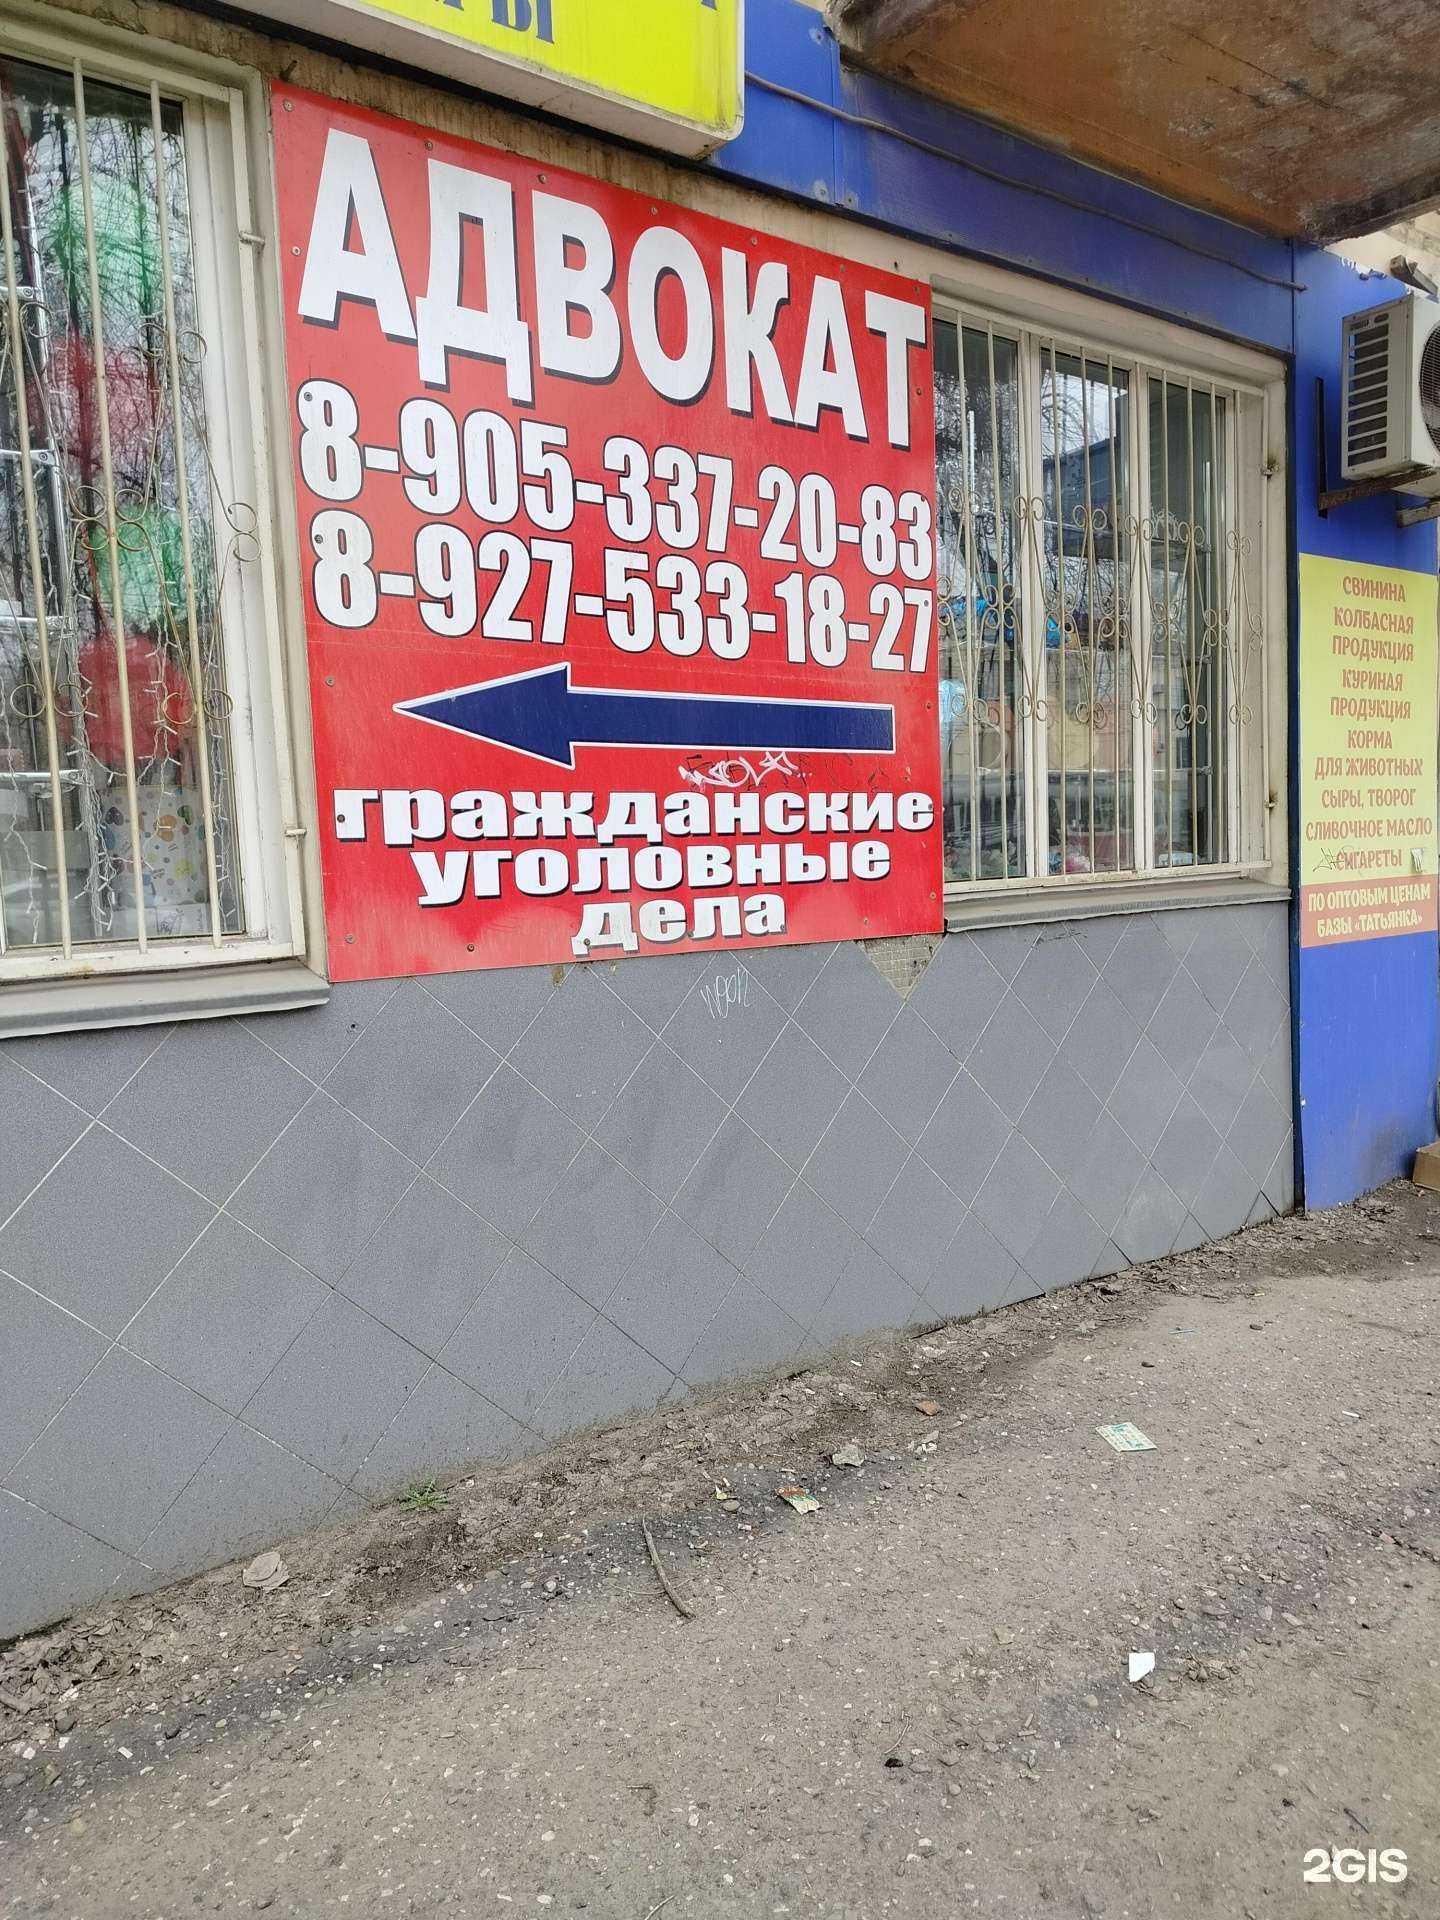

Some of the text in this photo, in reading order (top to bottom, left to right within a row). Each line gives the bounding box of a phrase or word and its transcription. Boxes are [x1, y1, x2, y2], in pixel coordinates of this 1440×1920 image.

[298, 128, 928, 451] АДВОКАТ
[298, 378, 933, 581] 8-905-337-20-83
[310, 509, 933, 673] 8-927-533-18-27
[1343, 576, 1406, 602] СВИНИНА
[1333, 606, 1414, 635] КОЛБАСНАЯ
[1332, 635, 1414, 664] ПРОДУКЦИЯ
[1342, 669, 1403, 691] КУРИНАЯ
[1330, 697, 1411, 722] ПРОДУКЦИЯ
[1347, 730, 1392, 749] КОРМА
[1315, 757, 1423, 780] ДЛЯ ЖИВОТНЫХ
[1321, 788, 1416, 810] СЫРЫ, ТВОРОГ
[332, 788, 935, 846] гражданские
[1306, 817, 1433, 841] СЛИВОЧНОЕ МАСЛО
[410, 838, 891, 907] уголовные
[1336, 848, 1403, 871] СИГАРЕТЫ
[1308, 883, 1431, 912] ПО ОПТОВЫМ ЦЕНАМ
[571, 893, 787, 957] дела
[1317, 917, 1353, 937] БАЗЫ
